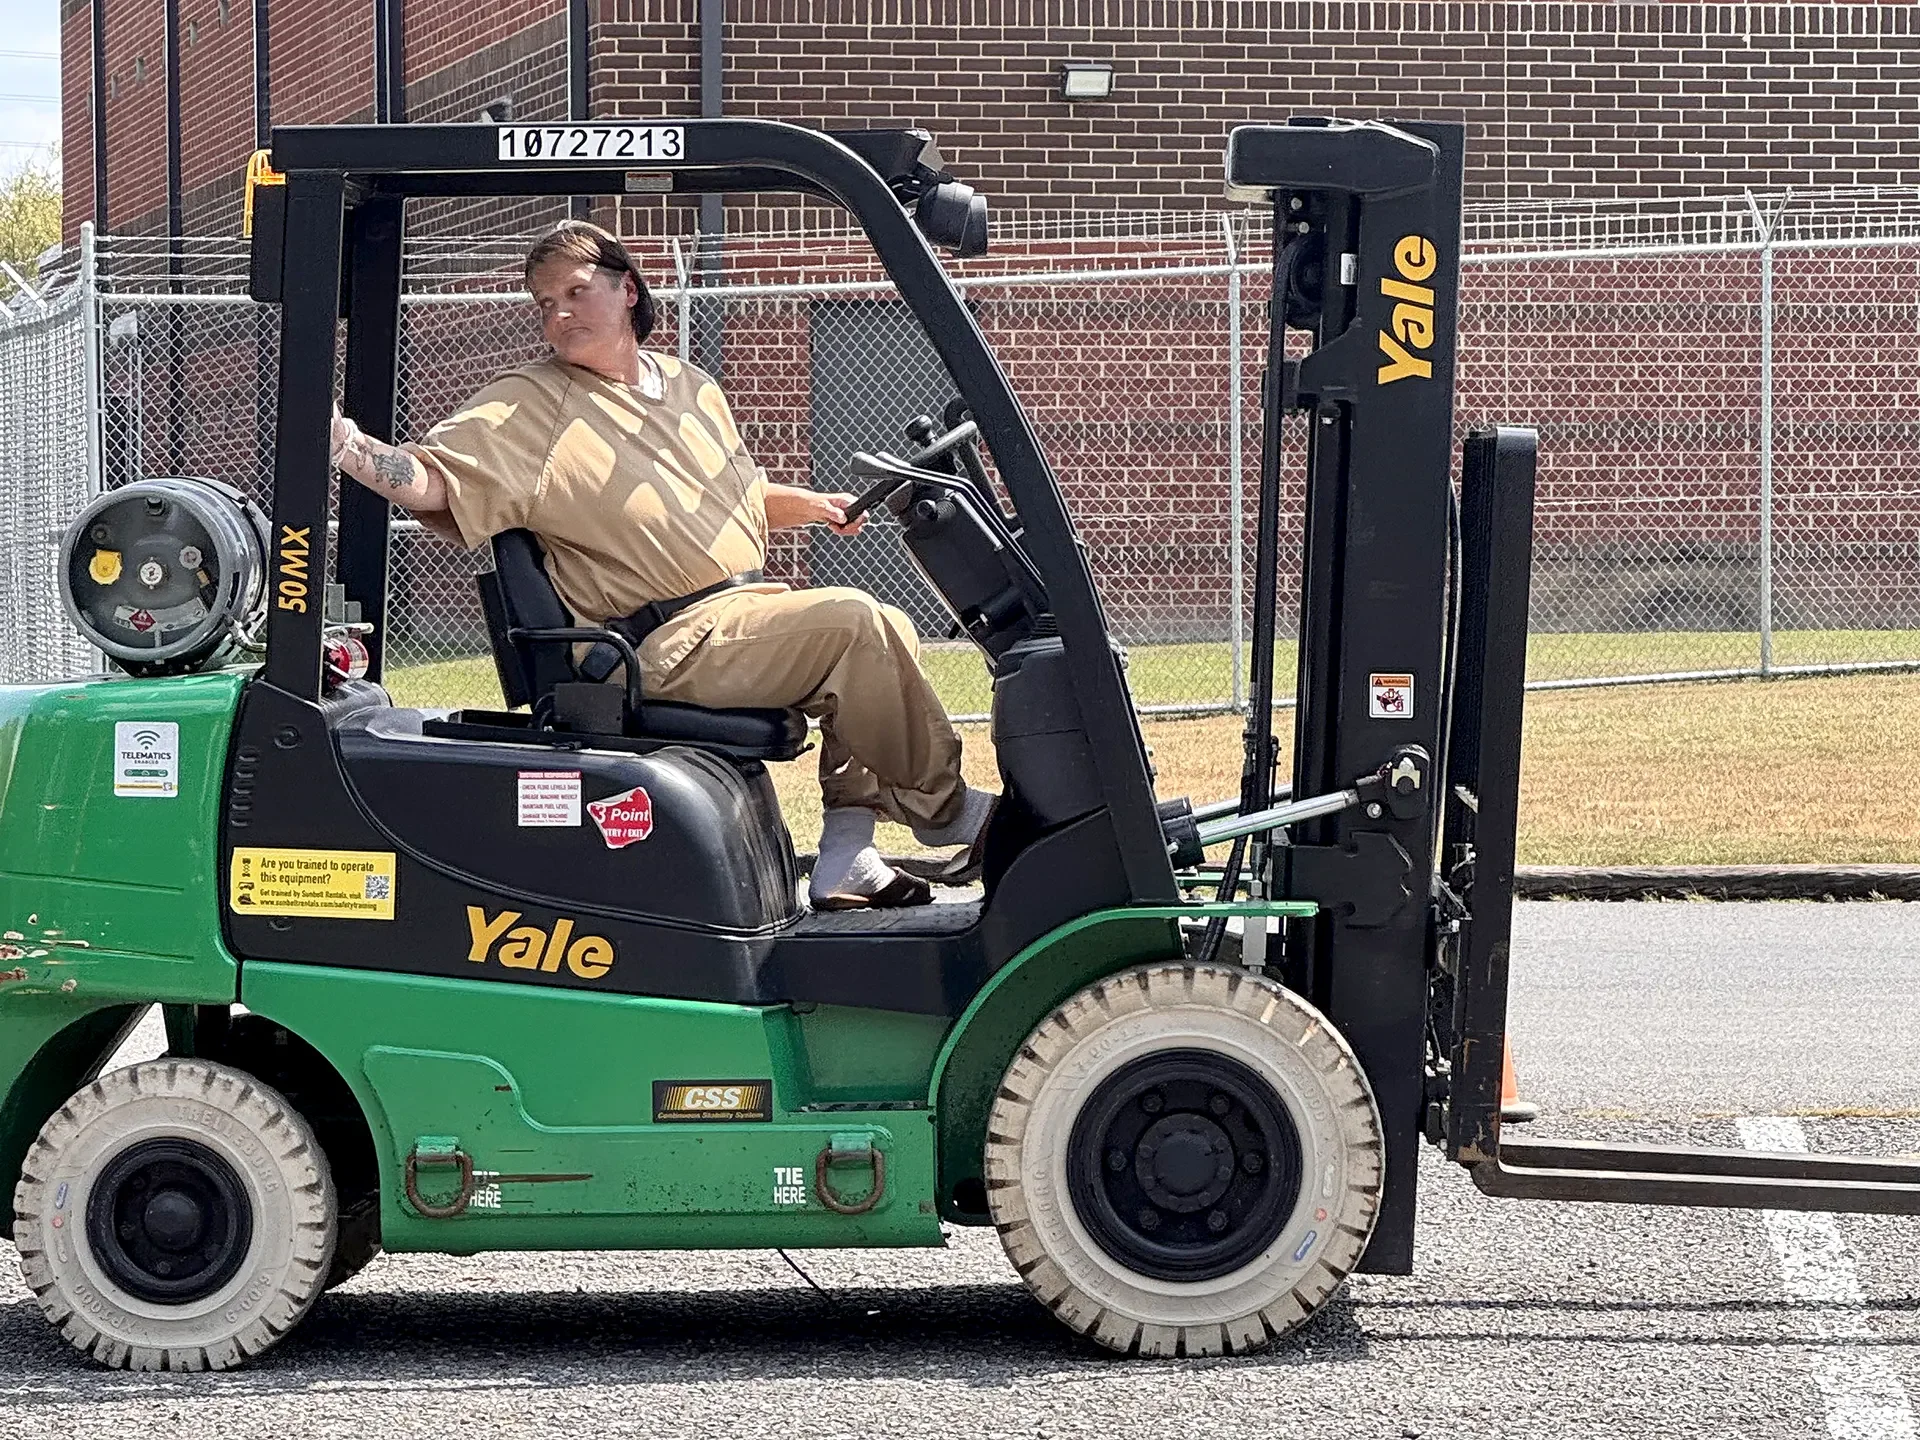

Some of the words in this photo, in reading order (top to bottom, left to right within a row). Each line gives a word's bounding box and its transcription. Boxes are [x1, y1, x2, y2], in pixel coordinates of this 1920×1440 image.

[502, 129, 681, 157] 10727213
[1377, 235, 1437, 385] Yale
[278, 524, 311, 614] 50MX
[121, 751, 172, 760] TELEMATICS
[595, 806, 607, 824] 3
[610, 808, 649, 822] Point
[628, 828, 644, 838] EXIT
[260, 857, 276, 868] Are
[278, 860, 295, 871] you
[296, 858, 328, 870] trained
[330, 861, 339, 871] to
[340, 861, 375, 874] operate
[260, 872, 277, 883] this
[279, 873, 331, 886] equipment?
[259, 888, 270, 896] Get
[271, 888, 292, 898] trained
[292, 889, 300, 899] by
[301, 889, 324, 899] Sunbelt
[349, 891, 362, 900] visit
[466, 905, 614, 979] Yale
[684, 1087, 742, 1109] CSS
[773, 1167, 804, 1185] TIE
[469, 1190, 502, 1209] HERE
[773, 1186, 806, 1204] HERE
